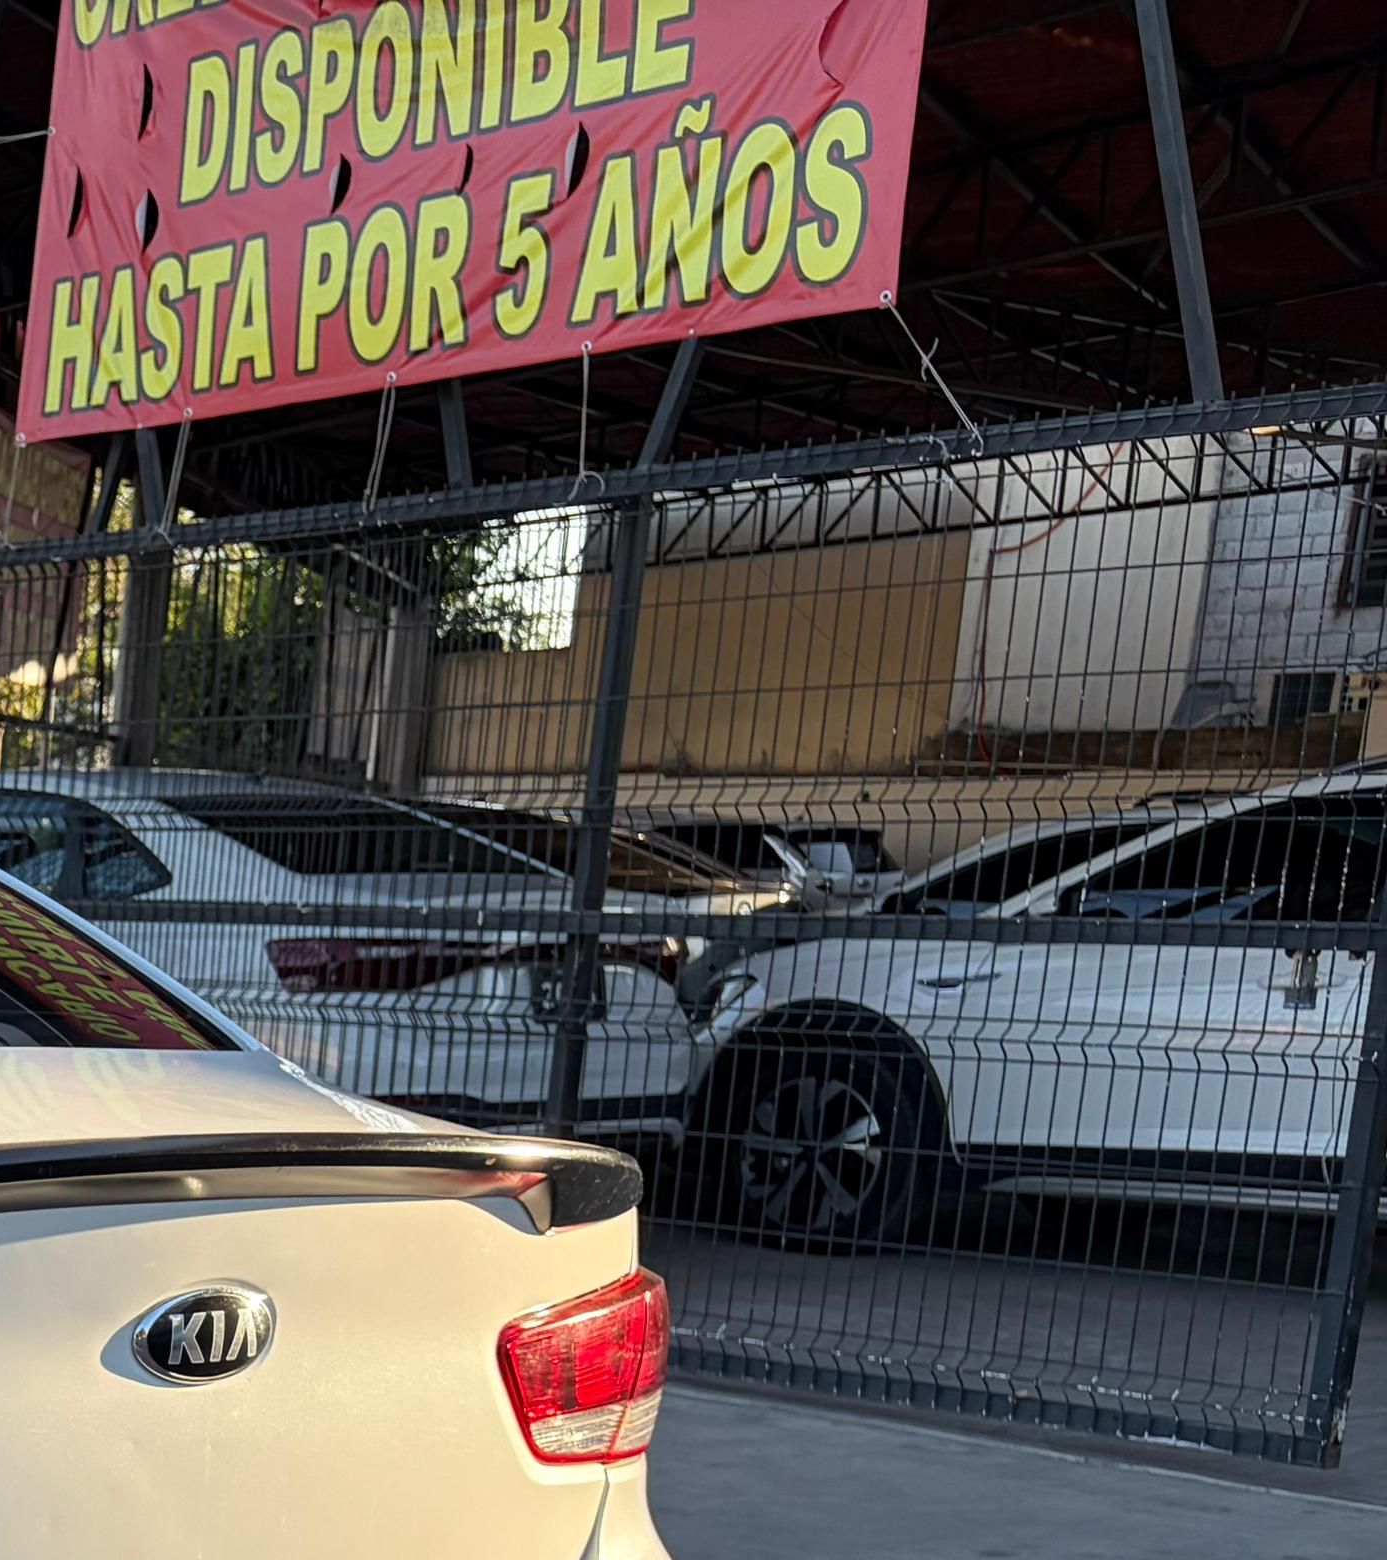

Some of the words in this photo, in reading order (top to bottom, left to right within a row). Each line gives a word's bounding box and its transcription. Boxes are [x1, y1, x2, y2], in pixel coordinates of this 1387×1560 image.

[179, 0, 692, 205] DISPONIBLE
[43, 237, 274, 415] HASTA
[296, 193, 471, 373] POR
[494, 173, 555, 338] 5
[570, 98, 869, 325] AÑOS
[168, 1308, 257, 1366] KIA
